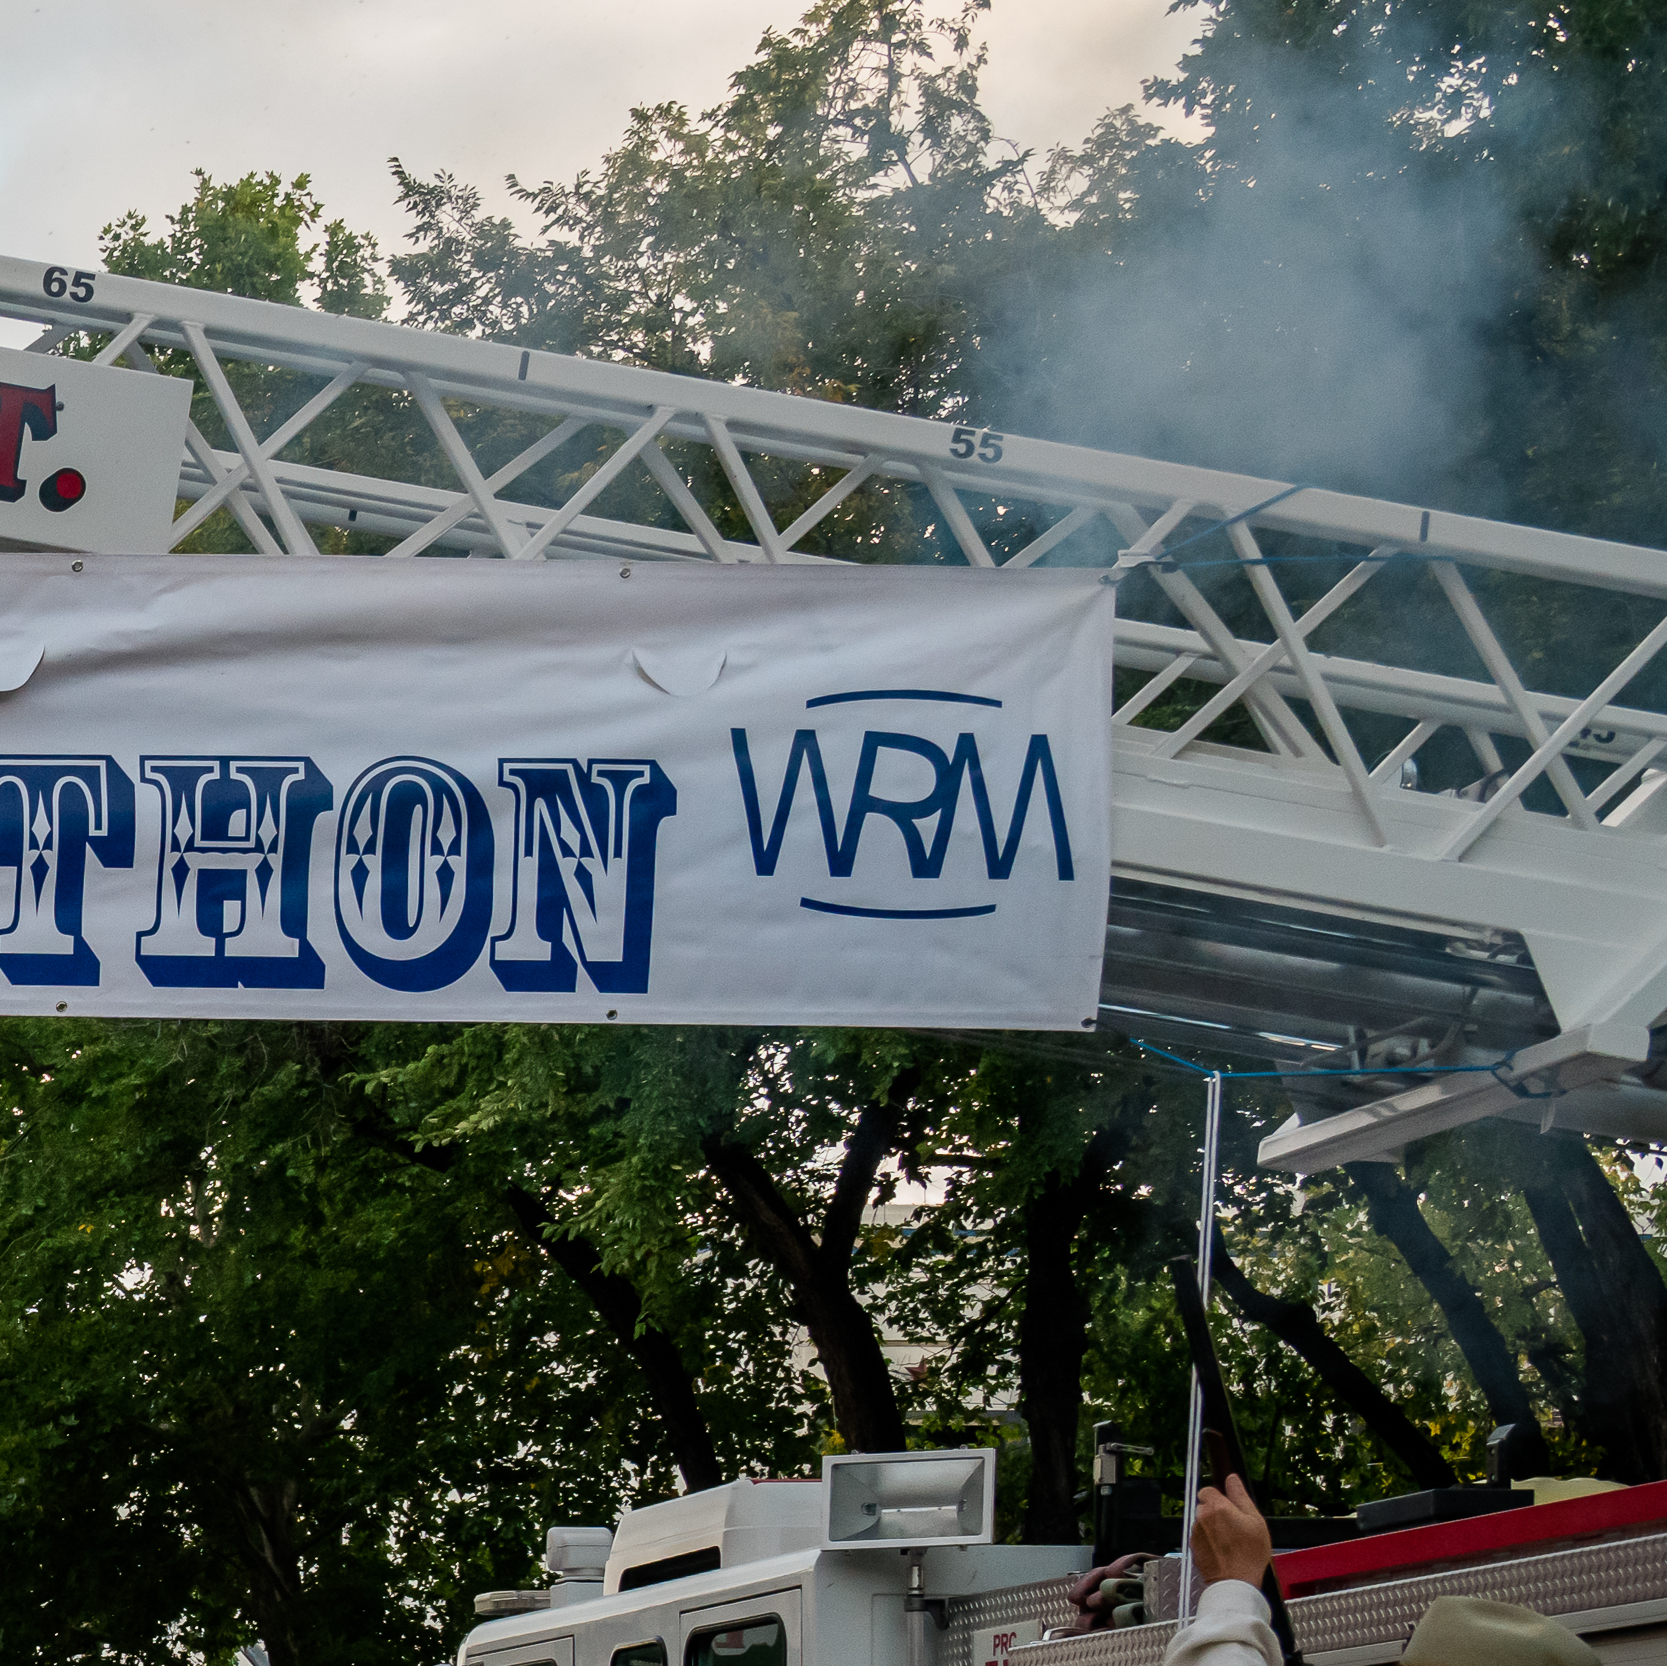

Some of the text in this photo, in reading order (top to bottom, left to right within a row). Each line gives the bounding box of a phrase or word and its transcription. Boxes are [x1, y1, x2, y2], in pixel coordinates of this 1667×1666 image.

[42, 265, 98, 304] 65
[950, 426, 1005, 464] 55
[730, 726, 1075, 882] WRM
